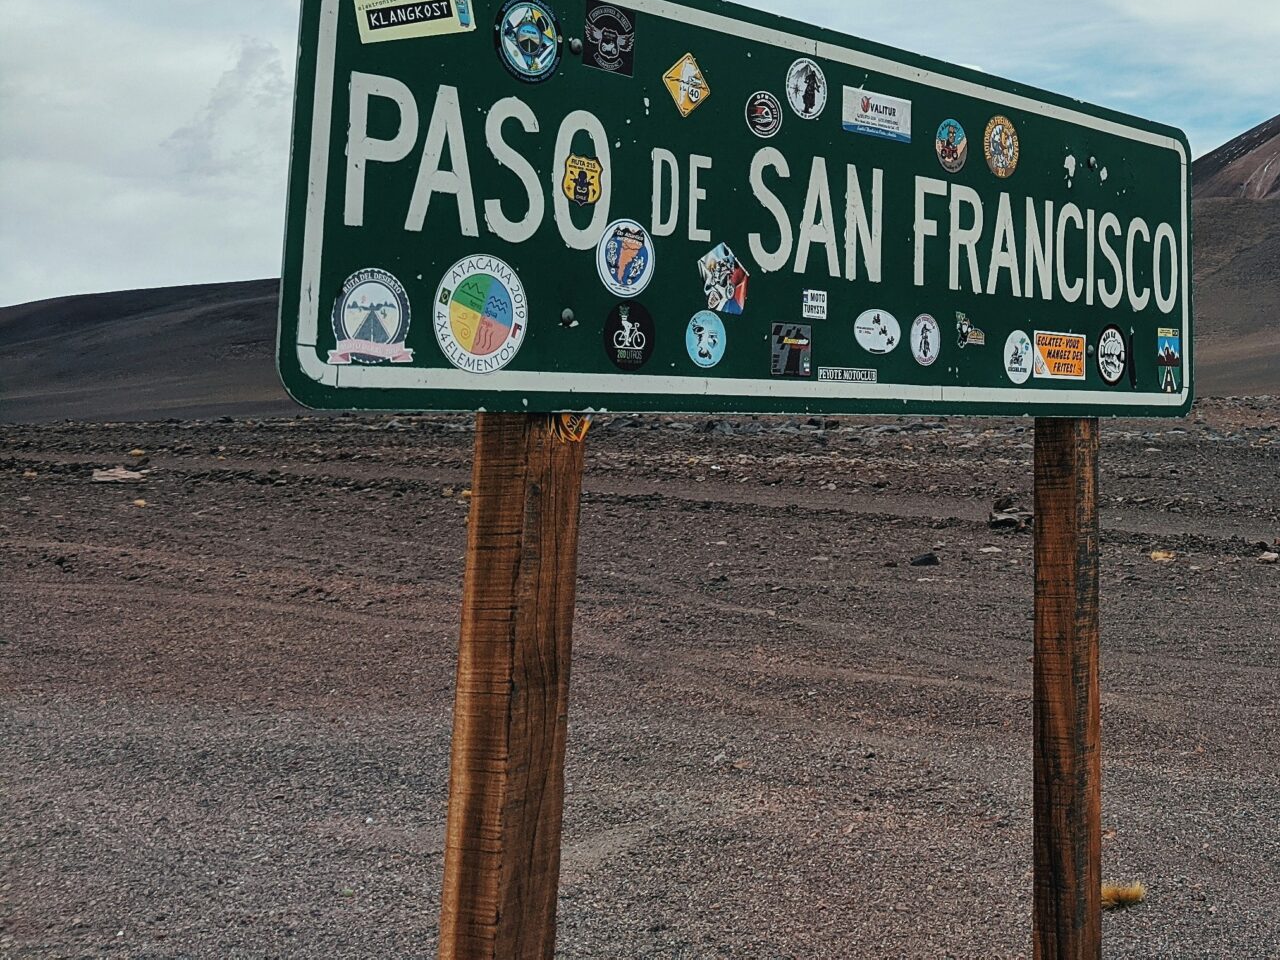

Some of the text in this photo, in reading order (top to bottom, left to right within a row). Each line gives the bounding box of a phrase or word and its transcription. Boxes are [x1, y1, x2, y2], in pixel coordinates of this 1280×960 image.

[369, 1, 448, 27] KLANGKOST
[690, 89, 700, 98] 40
[870, 102, 897, 117] VALITUR
[572, 158, 586, 167] RUTA
[344, 71, 1179, 314] PASO DE SAN FRANCISCO
[575, 193, 587, 201] CHILE
[342, 272, 402, 295] RUTA DEL DESIERTO
[451, 257, 526, 320] ATACAMA 2019
[810, 292, 826, 303] MOTO
[804, 303, 826, 315] TURYSTA
[436, 311, 515, 372] 4X4 ELEMENTOS
[626, 350, 642, 360] LITROS
[1046, 349, 1083, 361] MANGEZ DES
[1053, 361, 1076, 373] FRITES!
[819, 369, 877, 381] PEYOTE MOTOCLUB
